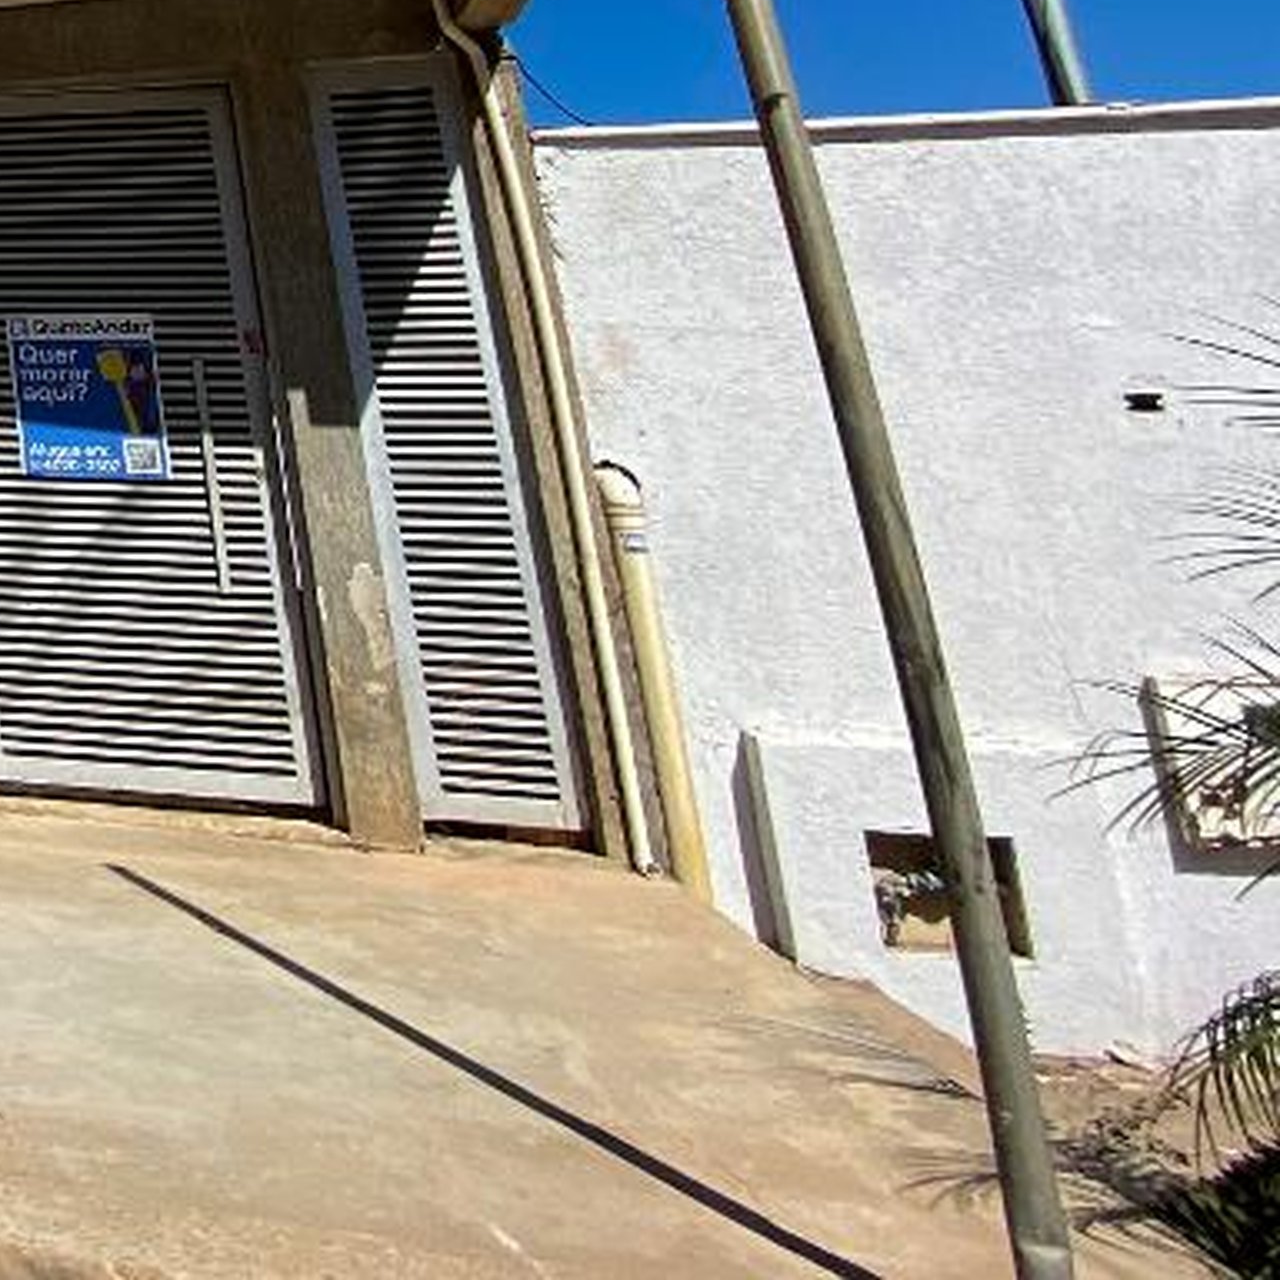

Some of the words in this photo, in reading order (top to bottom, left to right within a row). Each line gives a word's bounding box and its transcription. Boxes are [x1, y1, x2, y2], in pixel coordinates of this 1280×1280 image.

[19, 343, 78, 365] Quer
[20, 369, 90, 382] morar
[22, 384, 88, 408] aqui?
